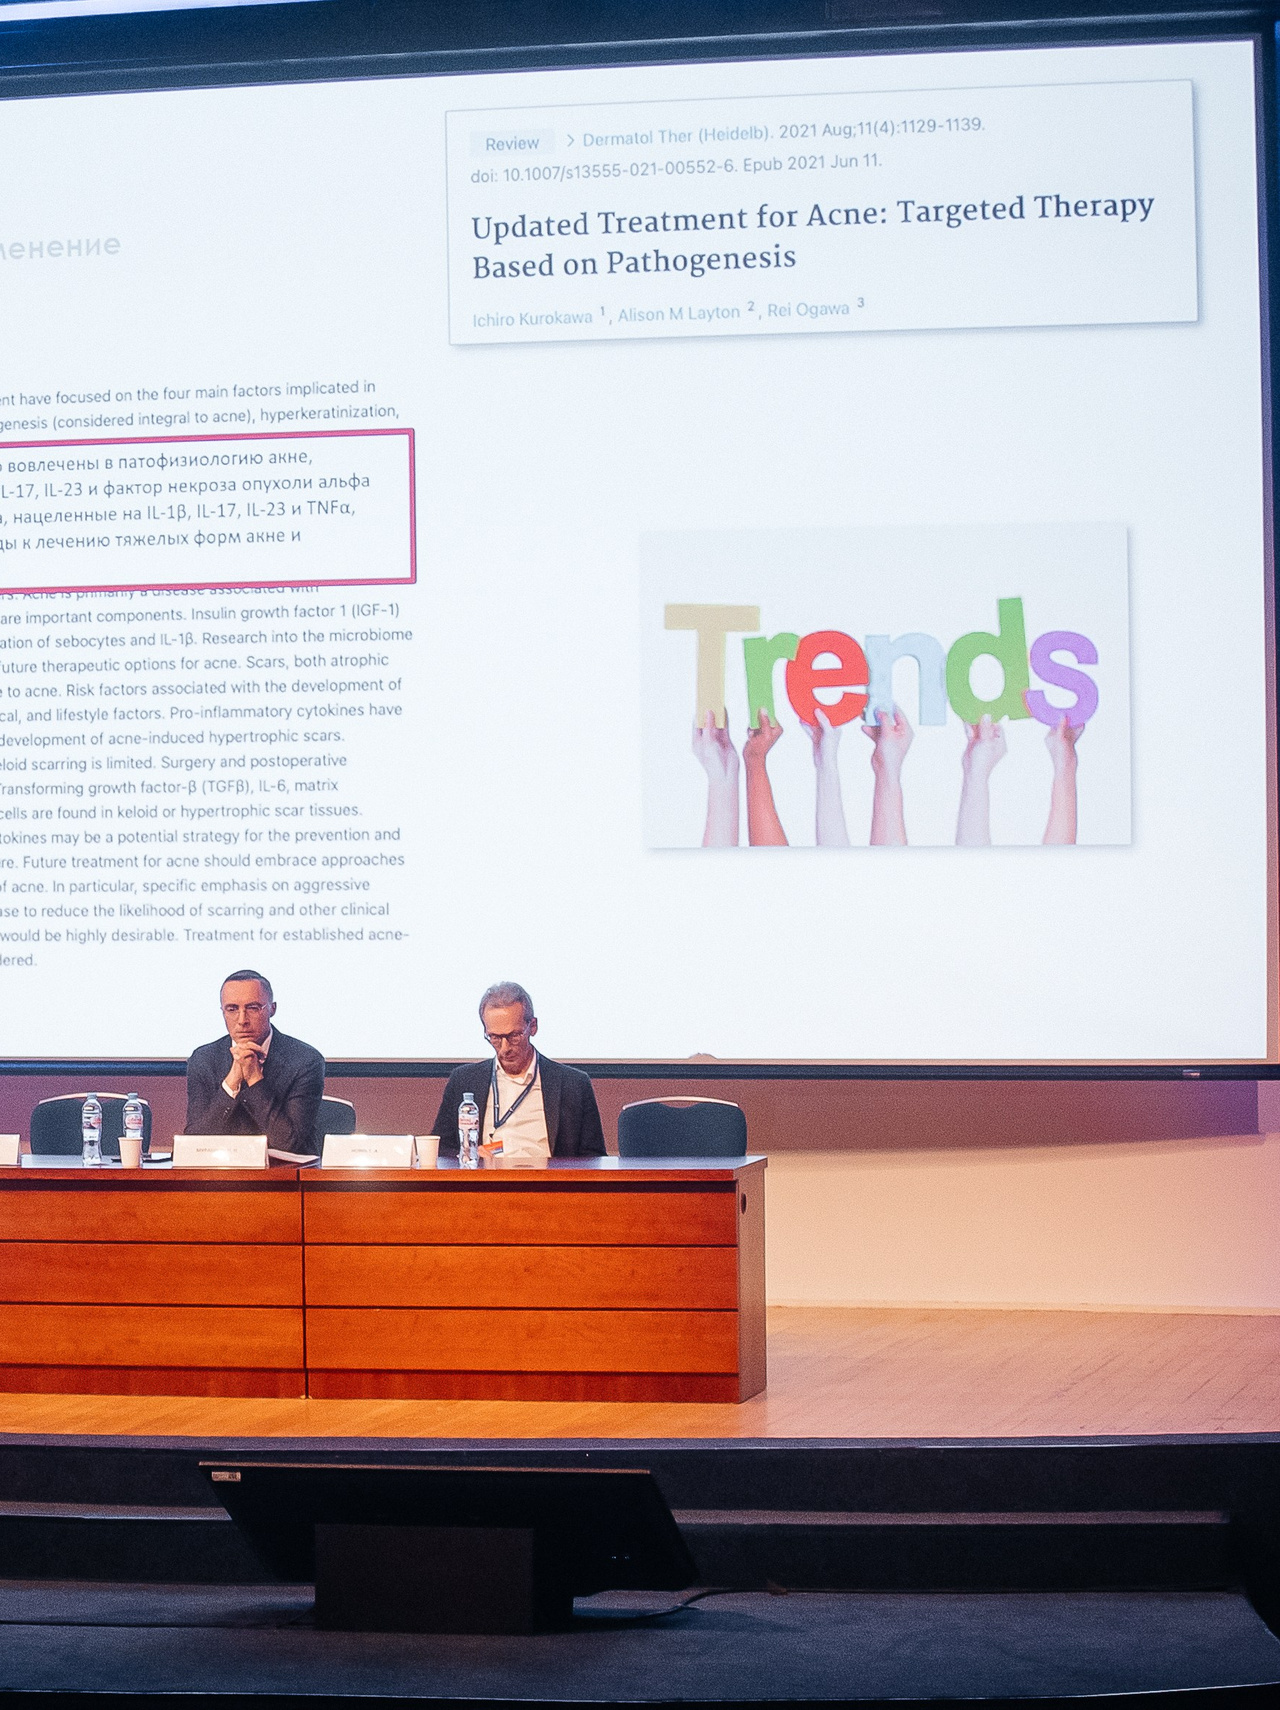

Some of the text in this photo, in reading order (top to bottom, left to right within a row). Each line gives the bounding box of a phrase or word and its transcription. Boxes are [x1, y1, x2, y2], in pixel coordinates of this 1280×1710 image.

[485, 115, 985, 152] Review Dermatol Ther (Heidelb). 2021 Aug;11(4):1129-1139.
[470, 151, 883, 184] doi: 10.1007/s13555-021-00552-6. Epub 2021 Jun 11.
[471, 193, 1155, 246] Updated Treatment for Acne: Targeted Therapy
[473, 243, 797, 279] Based on Pathogenesis
[472, 311, 516, 328] Ichiro
[518, 311, 594, 326] Kurokawa
[617, 306, 666, 323] Alison
[668, 305, 684, 320] M
[687, 305, 741, 322] Layton
[767, 301, 792, 318] Rei
[795, 301, 851, 320] Ogawa
[19, 391, 52, 406] have
[55, 388, 112, 405] focused
[114, 390, 133, 403] on
[136, 387, 160, 402] the
[162, 385, 191, 401] four
[194, 384, 229, 399] main
[232, 382, 282, 398] factors
[285, 380, 360, 398] implicated
[363, 378, 377, 393] in
[52, 412, 135, 430] (considered
[138, 410, 191, 427] integral
[194, 411, 209, 423] to
[212, 408, 256, 424] acne),
[260, 404, 400, 424] hyperkeratinization,
[7, 458, 100, 473] вовлечены
[104, 457, 114, 470] в
[118, 452, 264, 470] патофизиологию
[268, 451, 313, 465] акне,
[44, 481, 83, 497] IL-23
[88, 484, 99, 496] и
[102, 479, 163, 498] фактор
[167, 479, 237, 495] некроза
[241, 477, 313, 493] опухоли
[318, 471, 371, 491] альфа
[13, 509, 118, 525] нацеленные
[122, 508, 142, 521] на
[196, 502, 242, 519] IL-17,
[246, 500, 287, 517] IL-23
[291, 504, 302, 516] и
[22, 537, 32, 550] к
[35, 534, 111, 549] лечению
[114, 533, 189, 547] тяжелых
[193, 529, 242, 548] форм
[245, 529, 286, 543] акне
[290, 530, 302, 542] и
[0, 613, 22, 625] are
[25, 610, 93, 626] important
[95, 608, 187, 623] components.
[191, 605, 237, 620] Insulin
[239, 605, 290, 623] growth
[293, 603, 336, 618] factor
[339, 603, 347, 616] 1
[351, 601, 400, 619] (IGF-1)
[664, 597, 1100, 728] Trends
[26, 708, 53, 722] and
[55, 707, 110, 723] lifestyle
[112, 706, 165, 721] factors.
[169, 704, 293, 720] Pro-inflammatory
[296, 702, 365, 720] cytokines
[368, 701, 403, 716] have
[87, 780, 137, 798] growth
[258, 778, 290, 794] IL-6,
[294, 778, 339, 792] matrix
[31, 808, 54, 820] are
[57, 805, 97, 820] found
[100, 808, 114, 819] in
[117, 804, 159, 819] keloid
[161, 806, 177, 819] or
[180, 803, 271, 820] hypertrophic
[274, 805, 305, 817] scar
[308, 803, 363, 817] tissues.
